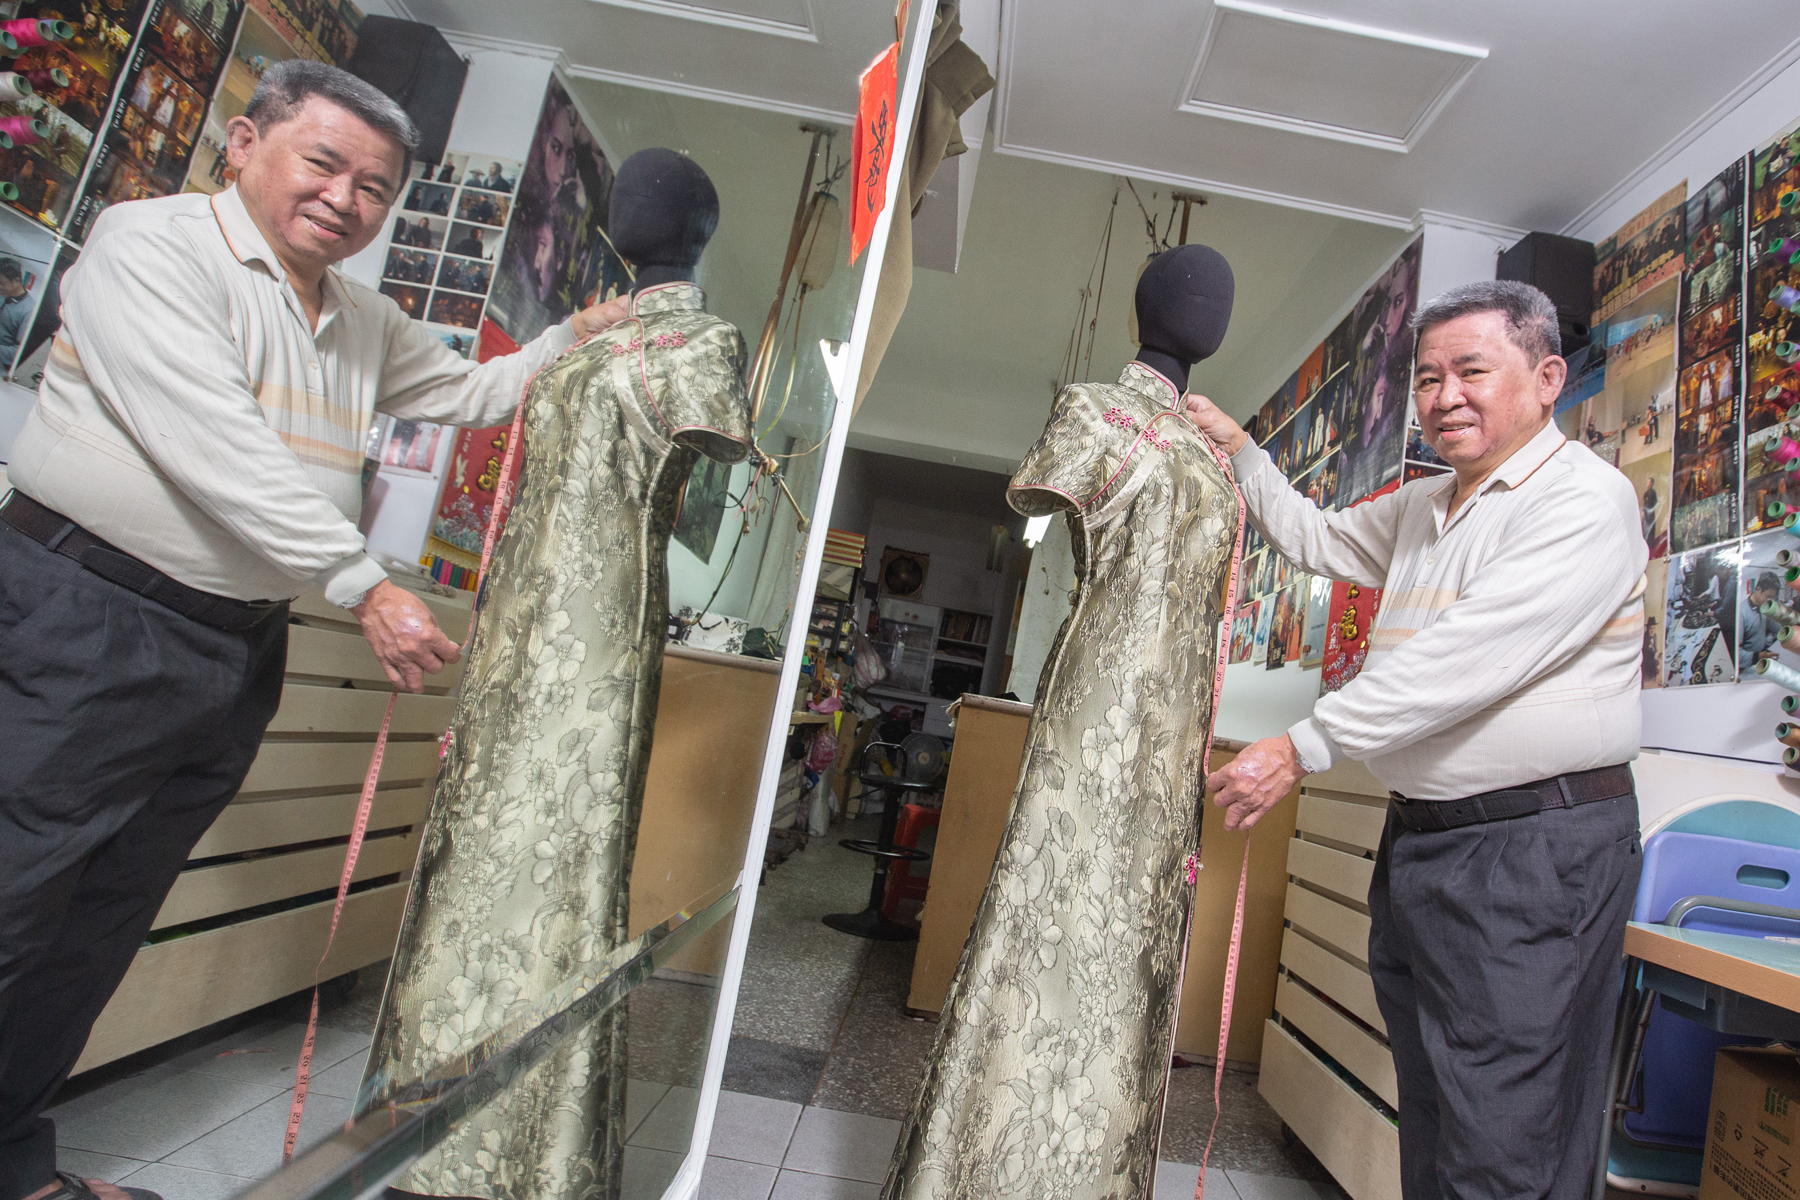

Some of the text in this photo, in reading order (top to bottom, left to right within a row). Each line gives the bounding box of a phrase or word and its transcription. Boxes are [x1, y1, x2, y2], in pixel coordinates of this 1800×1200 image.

[1235, 540, 1241, 548] 12
[1233, 556, 1239, 565] 13
[1231, 572, 1236, 580] 14
[1228, 589, 1235, 598] 15
[1226, 605, 1232, 615] 16
[1223, 622, 1230, 631] 17
[1221, 639, 1227, 648] 18
[1219, 655, 1225, 665] 19
[1216, 671, 1222, 682] 20
[1214, 688, 1220, 697] 21
